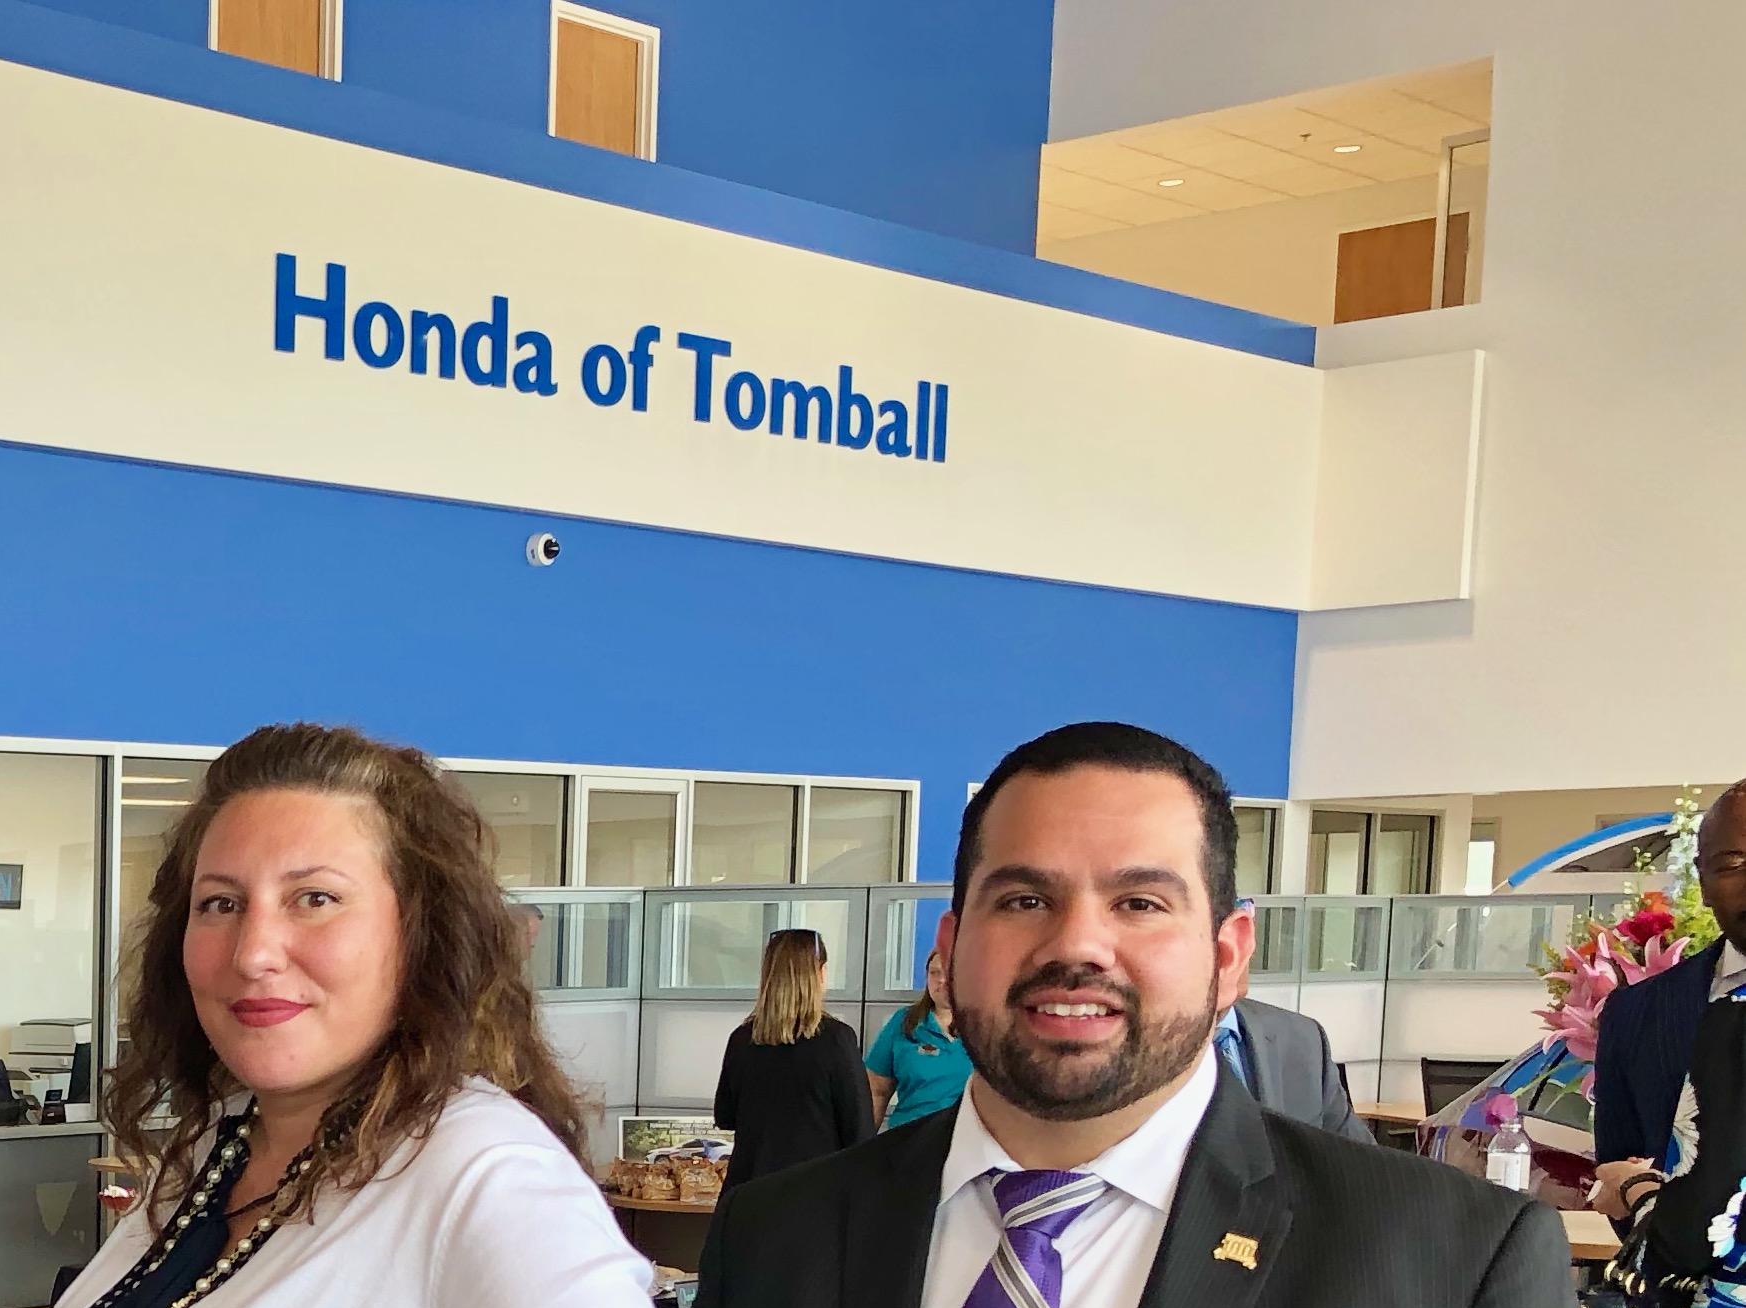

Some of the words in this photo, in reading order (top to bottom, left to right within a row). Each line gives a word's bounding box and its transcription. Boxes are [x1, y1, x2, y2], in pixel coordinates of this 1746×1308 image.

[274, 252, 558, 397] Honda
[581, 325, 661, 412] of
[677, 331, 949, 463] Tomball
